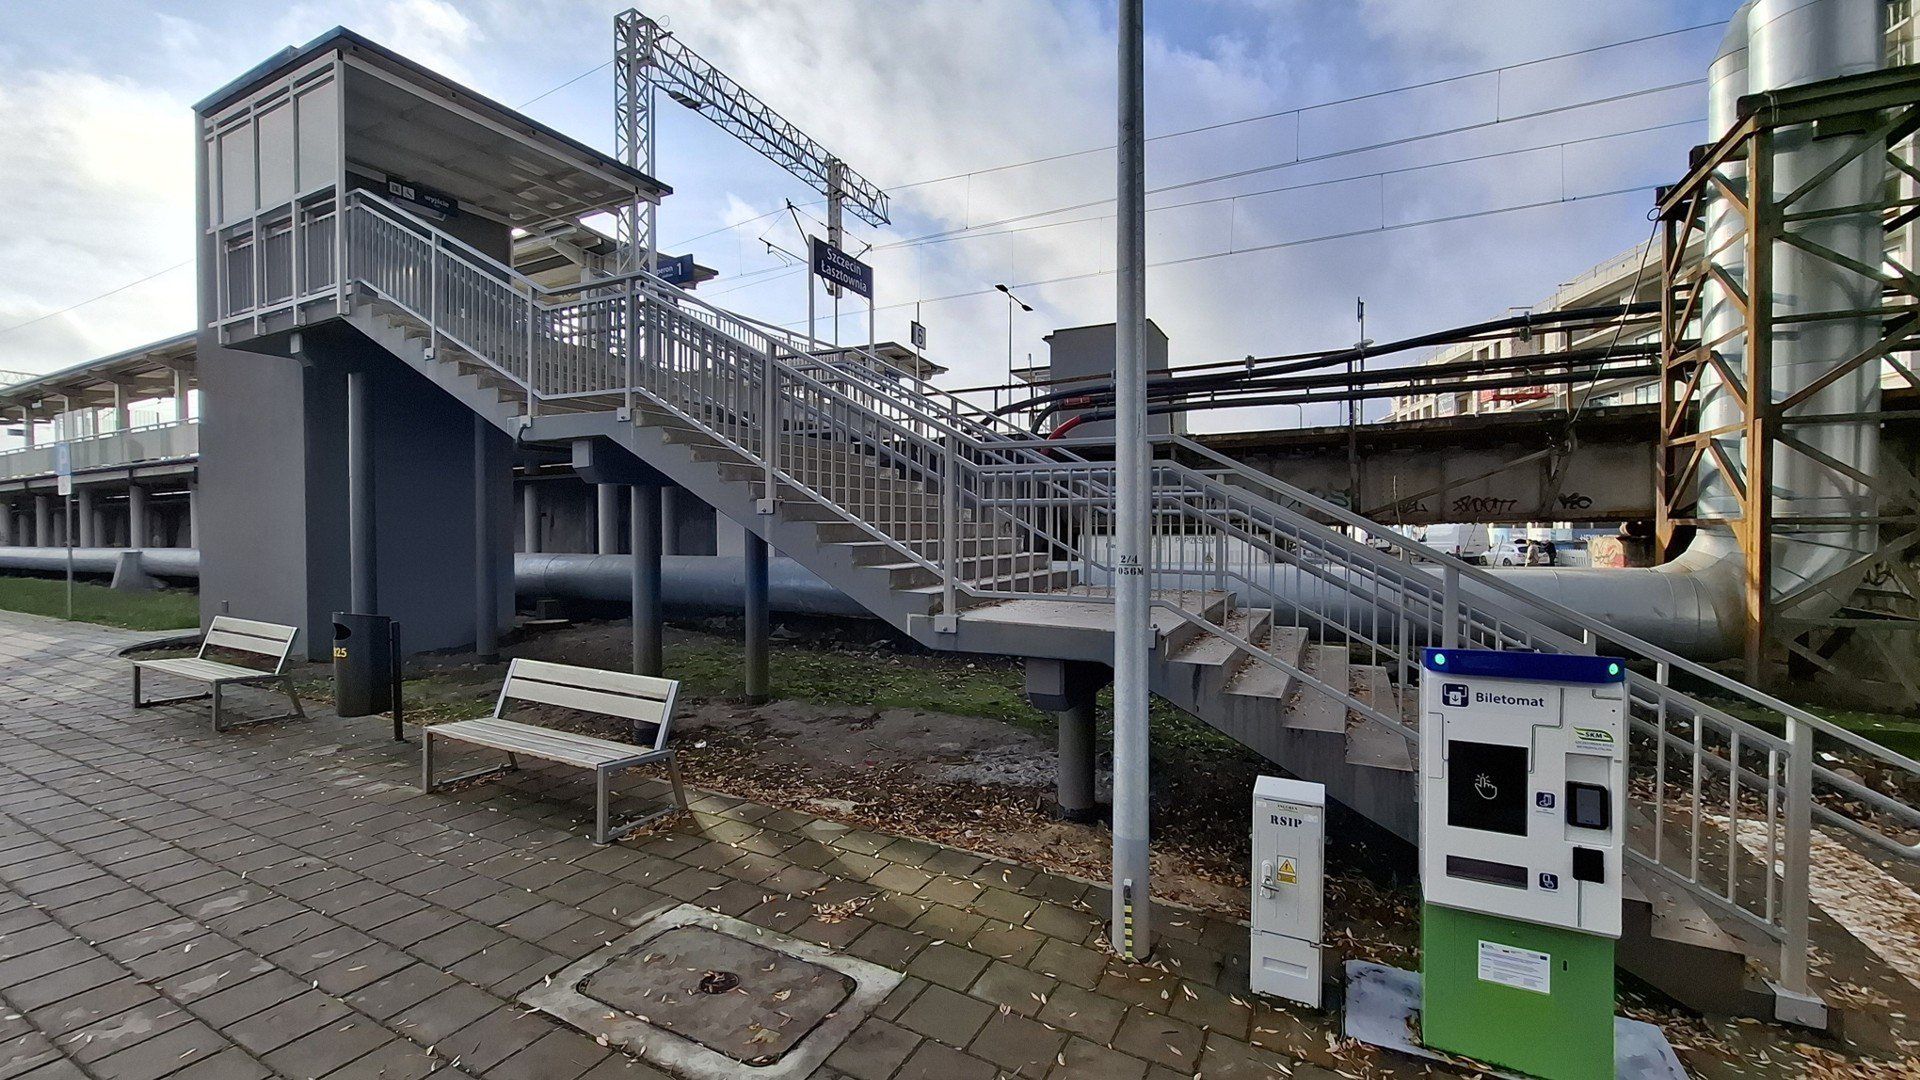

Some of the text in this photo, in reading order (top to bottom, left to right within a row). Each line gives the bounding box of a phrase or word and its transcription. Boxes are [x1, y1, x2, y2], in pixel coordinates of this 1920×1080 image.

[826, 247, 862, 276] Szczecin
[676, 262, 682, 276] 1
[821, 259, 868, 292] Łasztownia
[917, 327, 924, 345] 6
[1120, 554, 1138, 564] 2/4
[1476, 692, 1544, 707] Biletomat
[1585, 731, 1603, 739] SKM
[1270, 814, 1303, 828] RSIP
